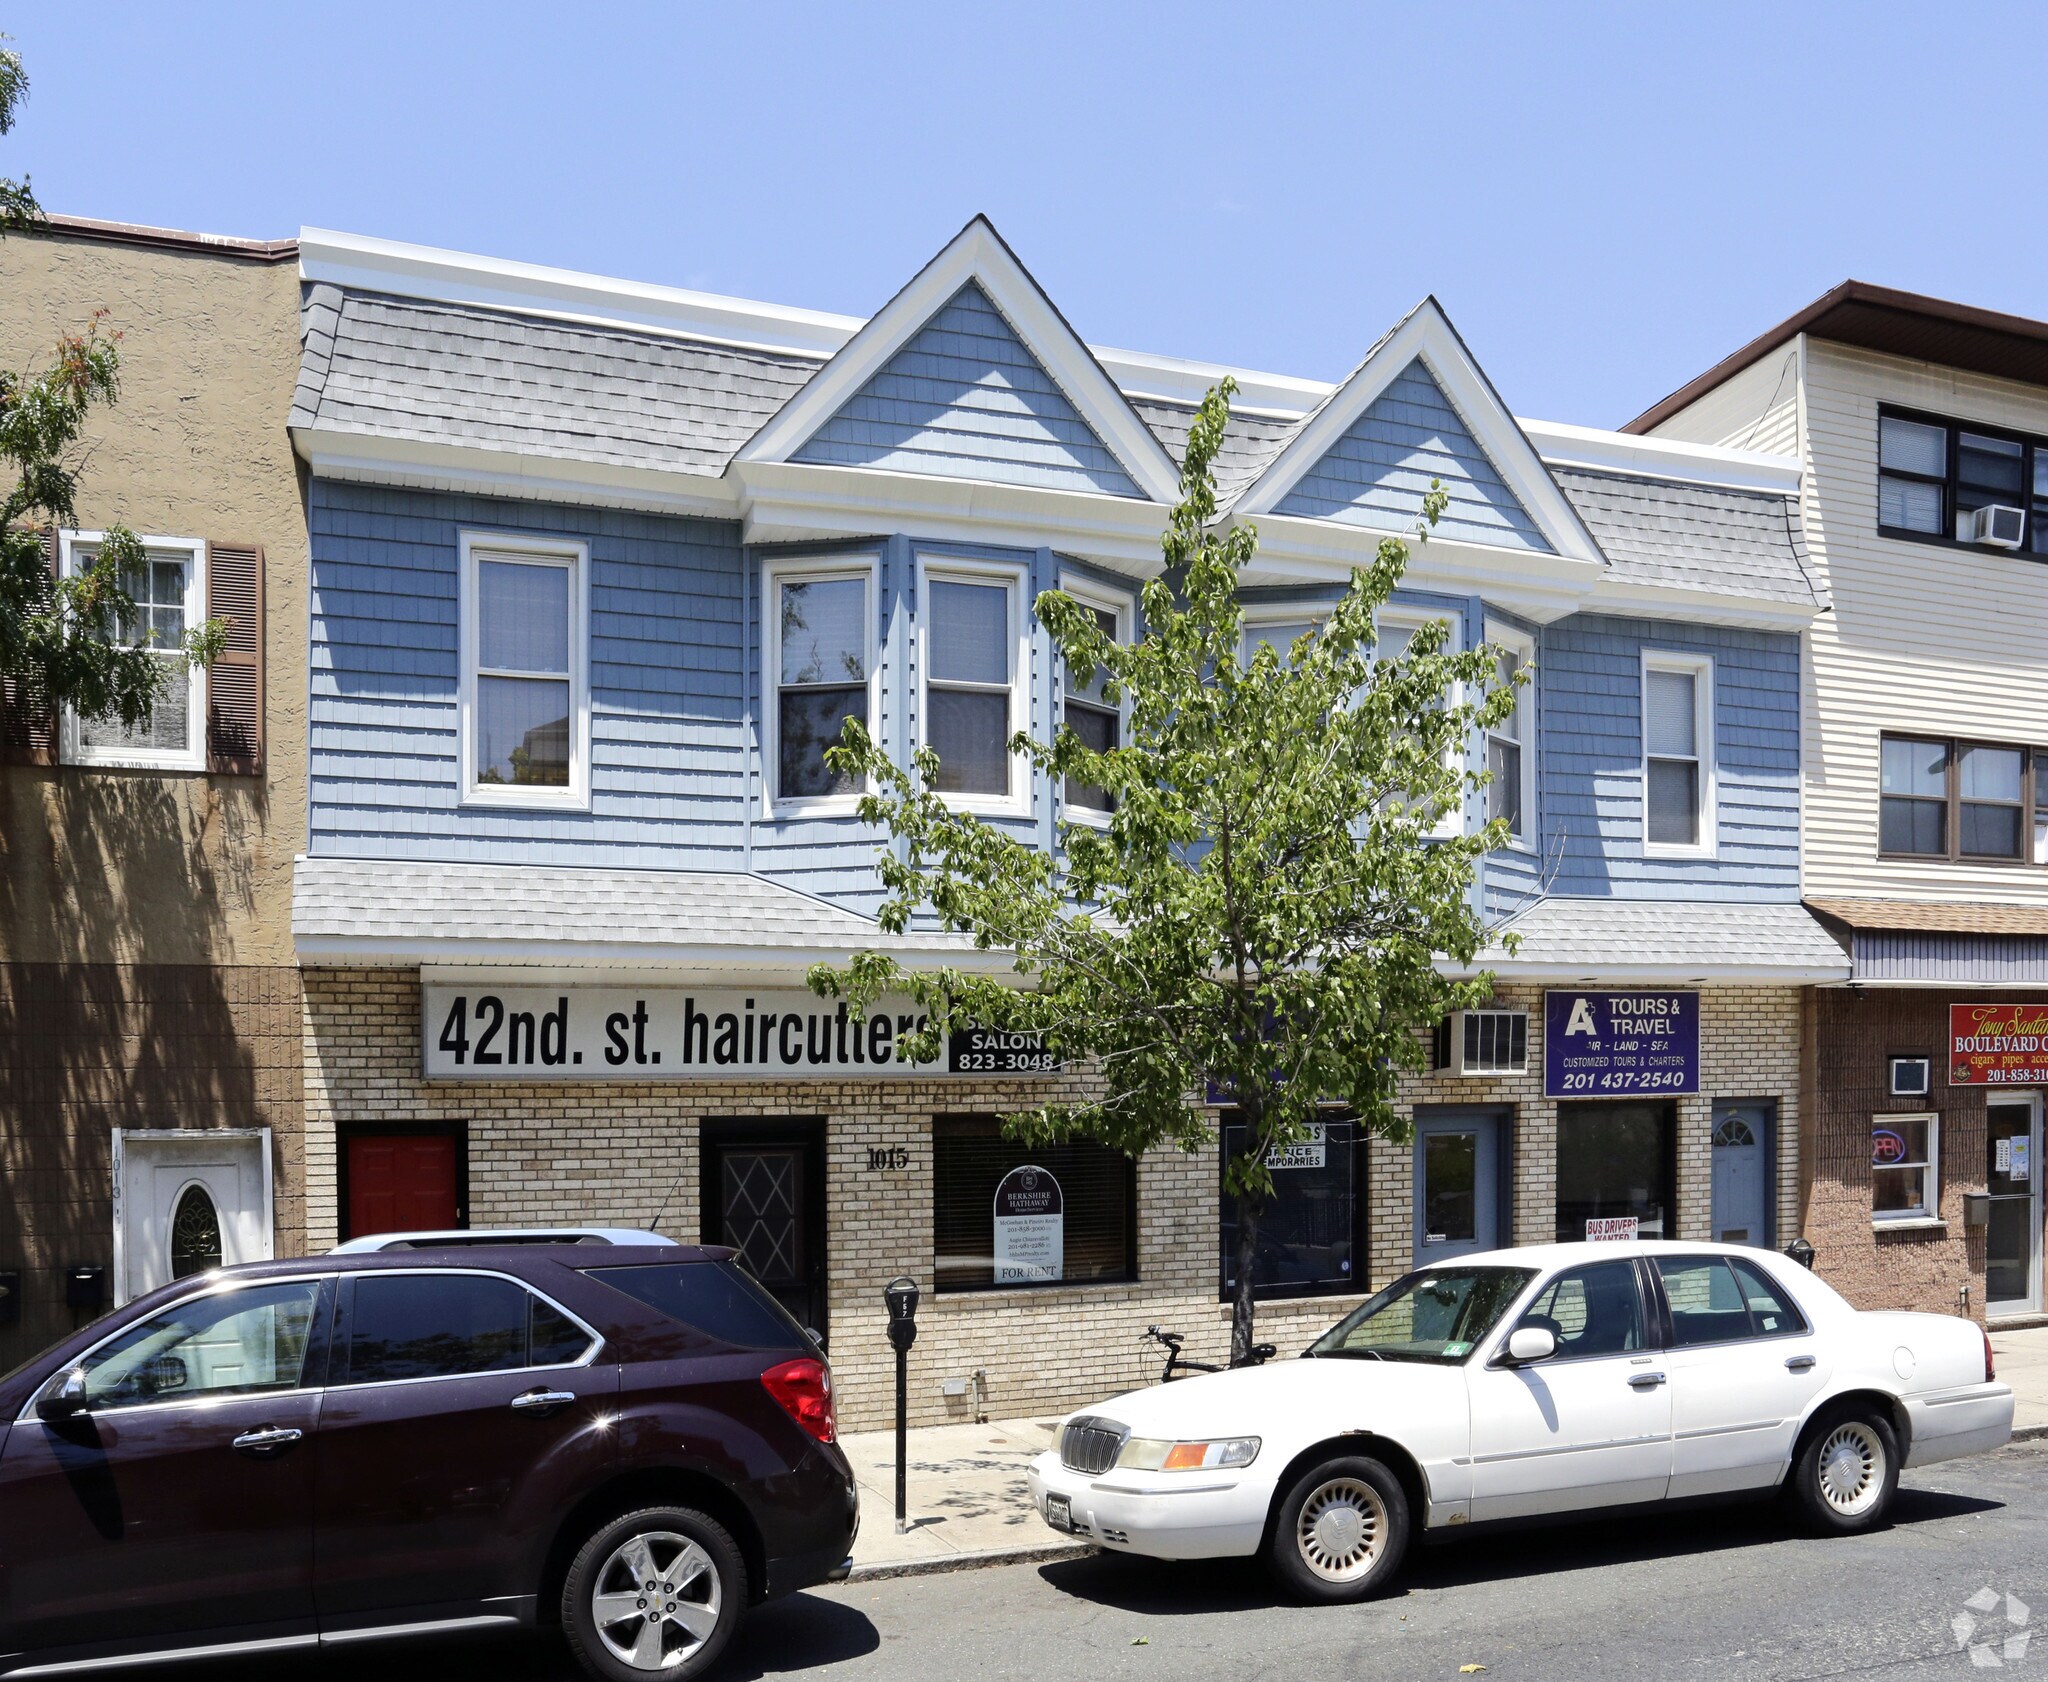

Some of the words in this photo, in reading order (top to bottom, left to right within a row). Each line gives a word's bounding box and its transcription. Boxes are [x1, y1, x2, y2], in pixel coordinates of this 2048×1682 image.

[1608, 998, 1668, 1015] TOURS
[1670, 998, 1681, 1015] &
[439, 996, 583, 1066] 42nd.
[604, 1000, 661, 1066] st.
[1610, 1019, 1676, 1035] TRAVEL
[1971, 1007, 2005, 1040] Tony
[2004, 1006, 2048, 1038] Santa
[971, 1034, 1041, 1050] SALON
[1613, 1041, 1639, 1051] LAND
[1650, 1040, 1669, 1051] SEA
[1954, 1035, 2039, 1053] BOULEVARD
[958, 1054, 1054, 1070] 823-3048
[1563, 1057, 1609, 1068] CUSTOMIZED
[1613, 1056, 1637, 1067] TOURS
[1639, 1056, 1645, 1067] &
[1648, 1055, 1685, 1067] CHARTERS
[1970, 1053, 1995, 1069] cigars
[2002, 1053, 2024, 1068] pipes
[1562, 1073, 1596, 1089] 201
[1600, 1071, 1685, 1089] 437-2540
[867, 1147, 908, 1170] 1015
[1263, 1156, 1320, 1167] EMPORARIES
[1007, 1192, 1051, 1201] BERKSHIRE
[1009, 1199, 1050, 1208] HATHAWAY
[1587, 1220, 1603, 1235] BUS
[1605, 1219, 1637, 1233] DRIVERS
[1002, 1267, 1024, 1279] FOR
[1027, 1265, 1057, 1277] RENT
